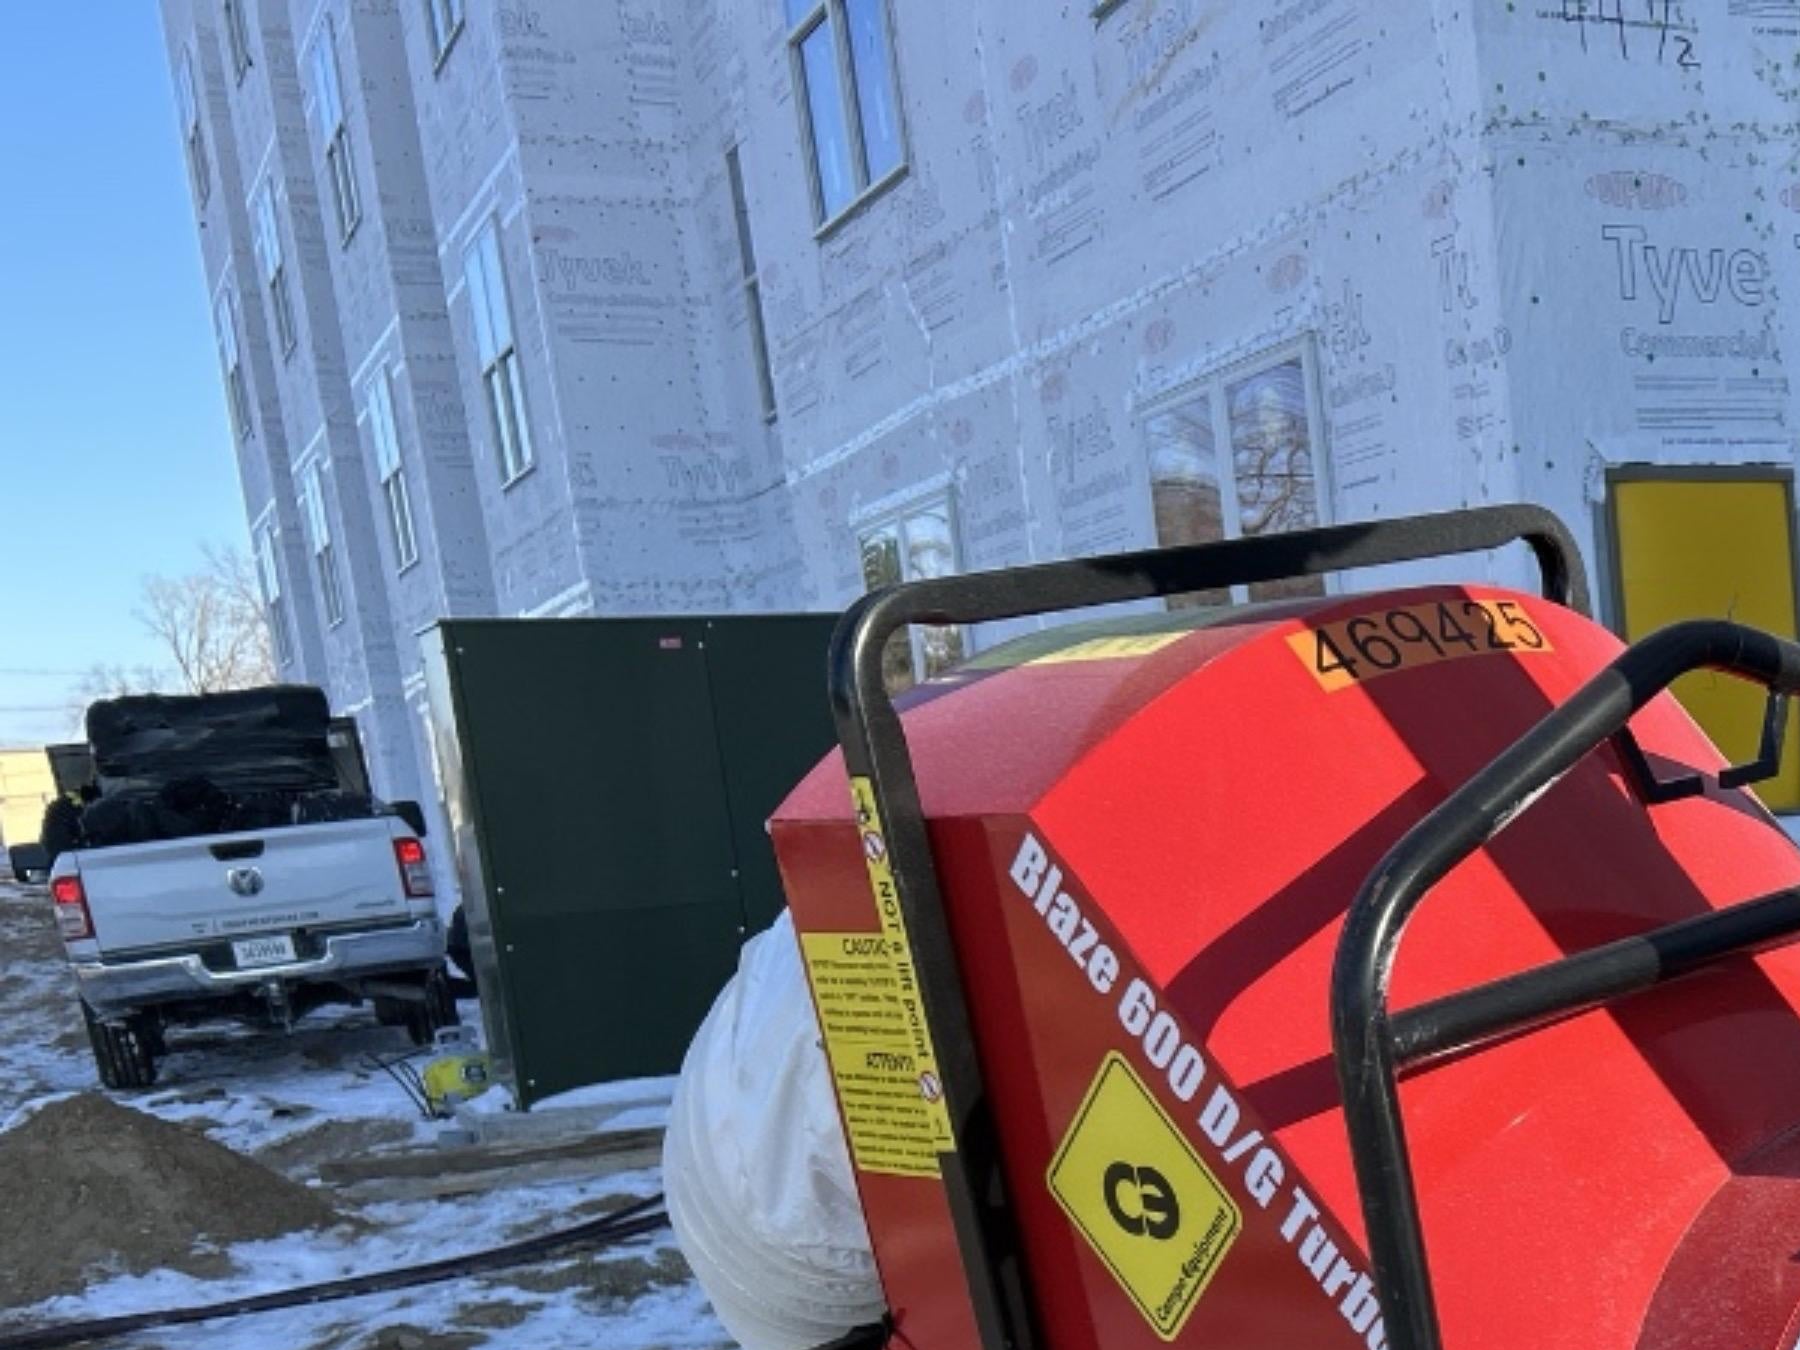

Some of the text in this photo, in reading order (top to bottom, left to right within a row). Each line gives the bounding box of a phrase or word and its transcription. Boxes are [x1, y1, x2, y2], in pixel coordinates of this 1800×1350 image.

[1602, 224, 1765, 324] Tyve
[1314, 600, 1543, 680] 469425
[878, 880, 901, 933] NOT
[896, 960, 914, 992] lift
[902, 998, 930, 1058] point
[1008, 832, 1120, 995] Blaze
[1117, 977, 1208, 1102] 600
[1196, 1082, 1286, 1210] D/G
